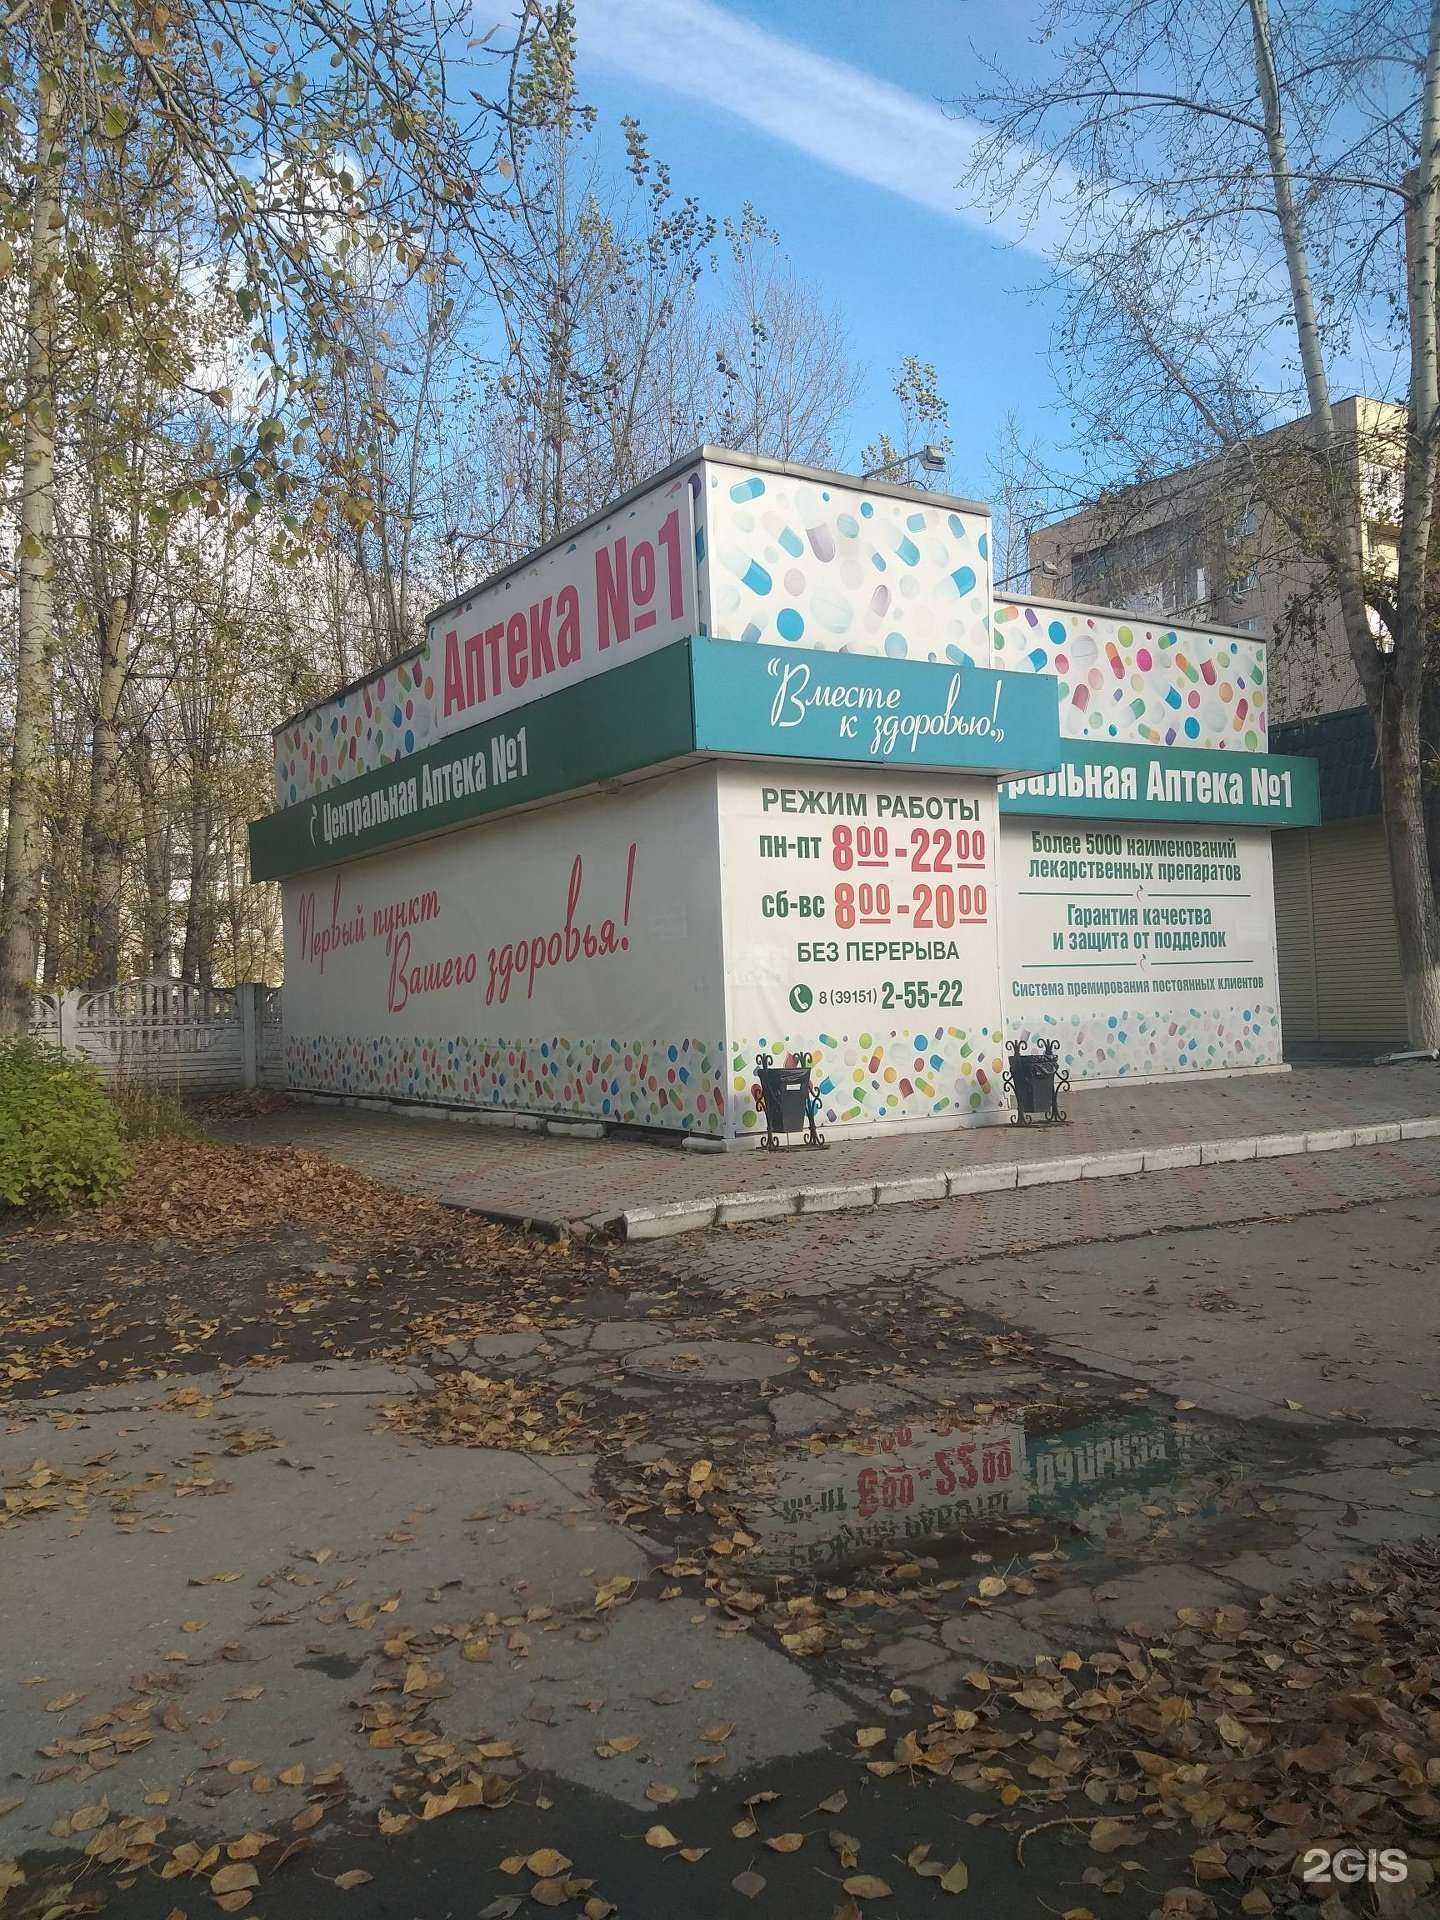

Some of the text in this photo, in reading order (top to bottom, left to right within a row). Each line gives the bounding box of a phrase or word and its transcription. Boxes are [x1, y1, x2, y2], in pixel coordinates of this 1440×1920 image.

[443, 508, 685, 719] Аптека №1
[839, 714, 858, 738] к
[322, 726, 529, 845] Центральная Аптека №1
[997, 761, 1293, 808] ральная Аптека №1
[761, 787, 981, 822] РЕЖИМ РАБОТЫ
[1031, 830, 1237, 859] Более 5000 наименований
[1028, 858, 1241, 883] лекарственных препаратов
[299, 873, 441, 976] Первый пункт
[387, 842, 637, 1015] Вашего здоровья!
[1067, 903, 1212, 928] Гарантия качества
[797, 941, 960, 963] БЕЗ ПЕРЕРЫВА
[1053, 930, 1227, 953] и защита от подделок
[819, 979, 963, 1010] 8 (39151) 2-55-22
[1012, 975, 1265, 998] Система премирования постоянных клиентов
